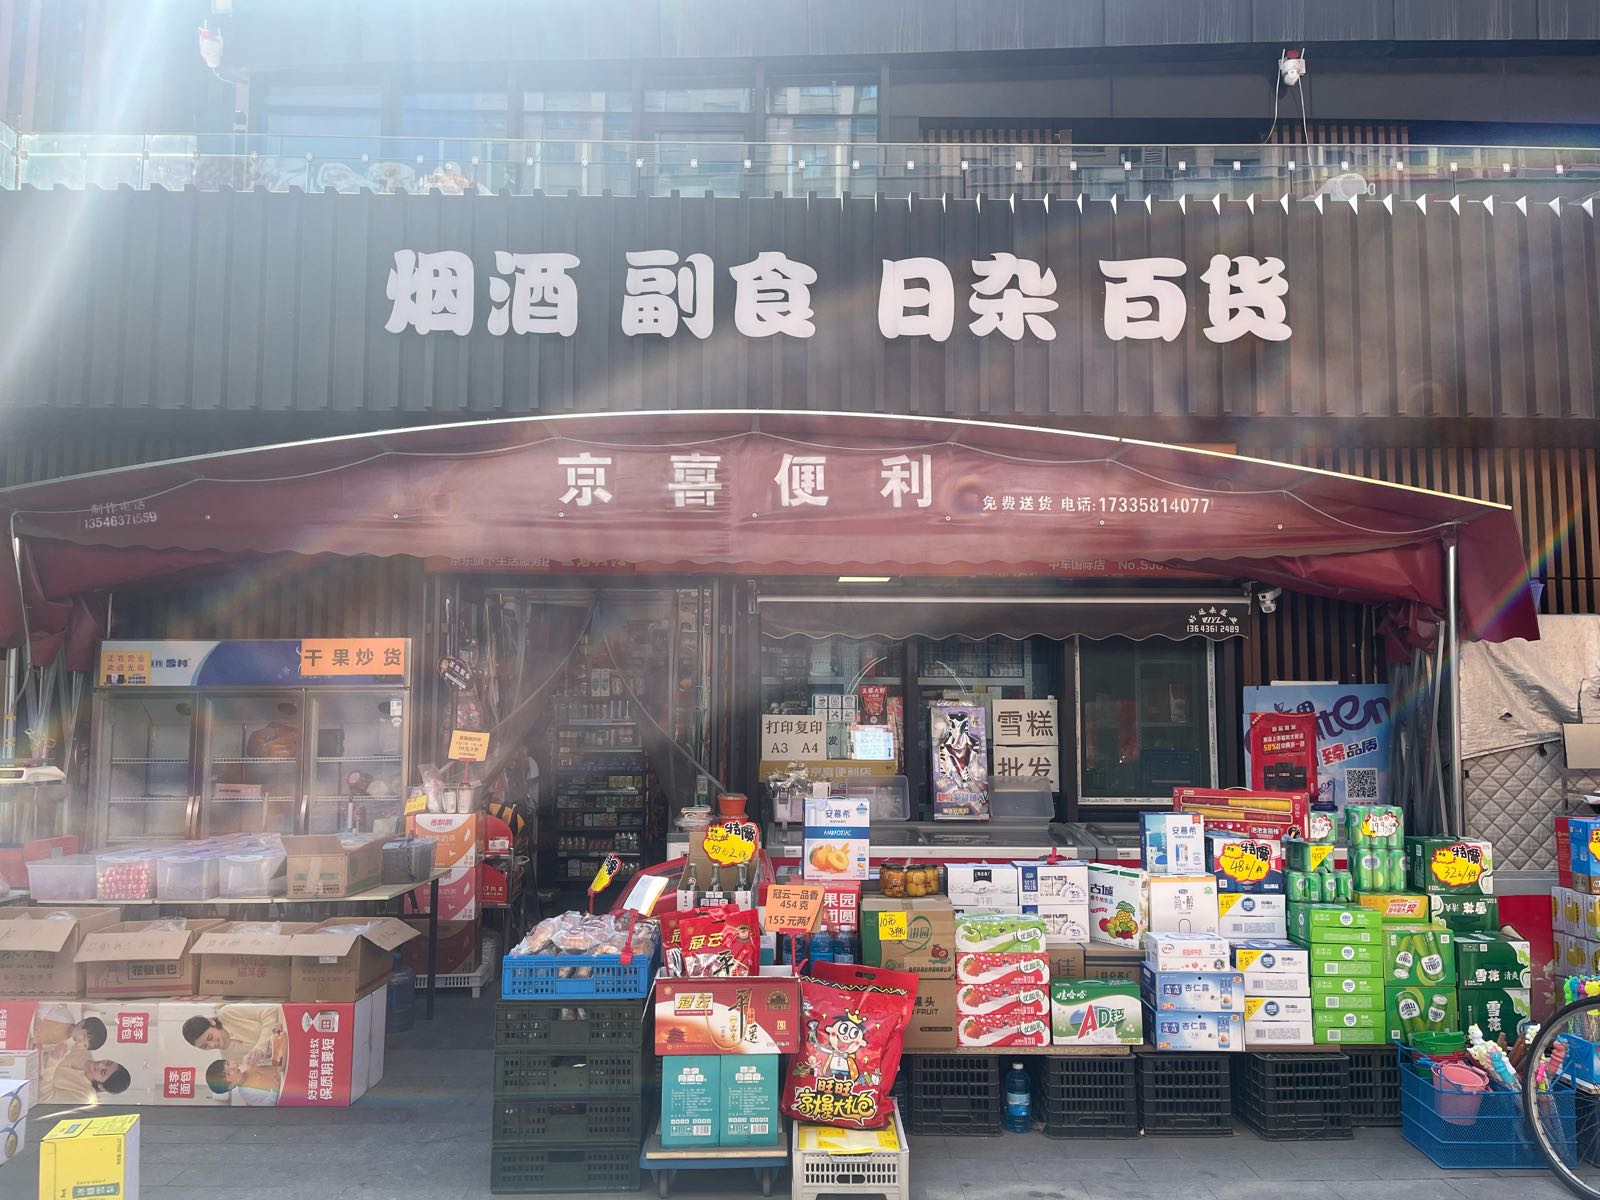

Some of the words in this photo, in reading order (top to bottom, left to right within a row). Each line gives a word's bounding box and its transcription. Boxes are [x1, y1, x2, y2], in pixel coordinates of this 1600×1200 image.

[385, 248, 580, 338] 烟酒
[621, 250, 818, 340] 副食
[879, 252, 1060, 343] 日杂
[1099, 253, 1293, 345] 百货
[557, 452, 935, 510] 京喜便利
[982, 495, 1053, 512] 免费送货
[304, 648, 402, 667] 干果炒货
[765, 720, 823, 735] 打印复印
[997, 710, 1053, 738] 雪糕
[771, 743, 789, 754] A3
[801, 743, 819, 754] A4
[997, 756, 1054, 784] 批发
[823, 892, 856, 908] 果园
[1019, 931, 1041, 943] 优酸乳
[1022, 959, 1043, 971] 优酸乳
[1475, 968, 1500, 983] 雪花
[1023, 989, 1043, 1001] 优酸乳
[1056, 989, 1086, 1001] 娃哈哈
[916, 1008, 939, 1016] FRUIT
[1486, 1000, 1502, 1032] 雪花
[1023, 1020, 1043, 1033] 优酸乳
[319, 1038, 335, 1100] 保质期要短
[168, 1070, 179, 1096] 桃李
[180, 1070, 192, 1096] 面包
[816, 1079, 853, 1095] 旺旺
